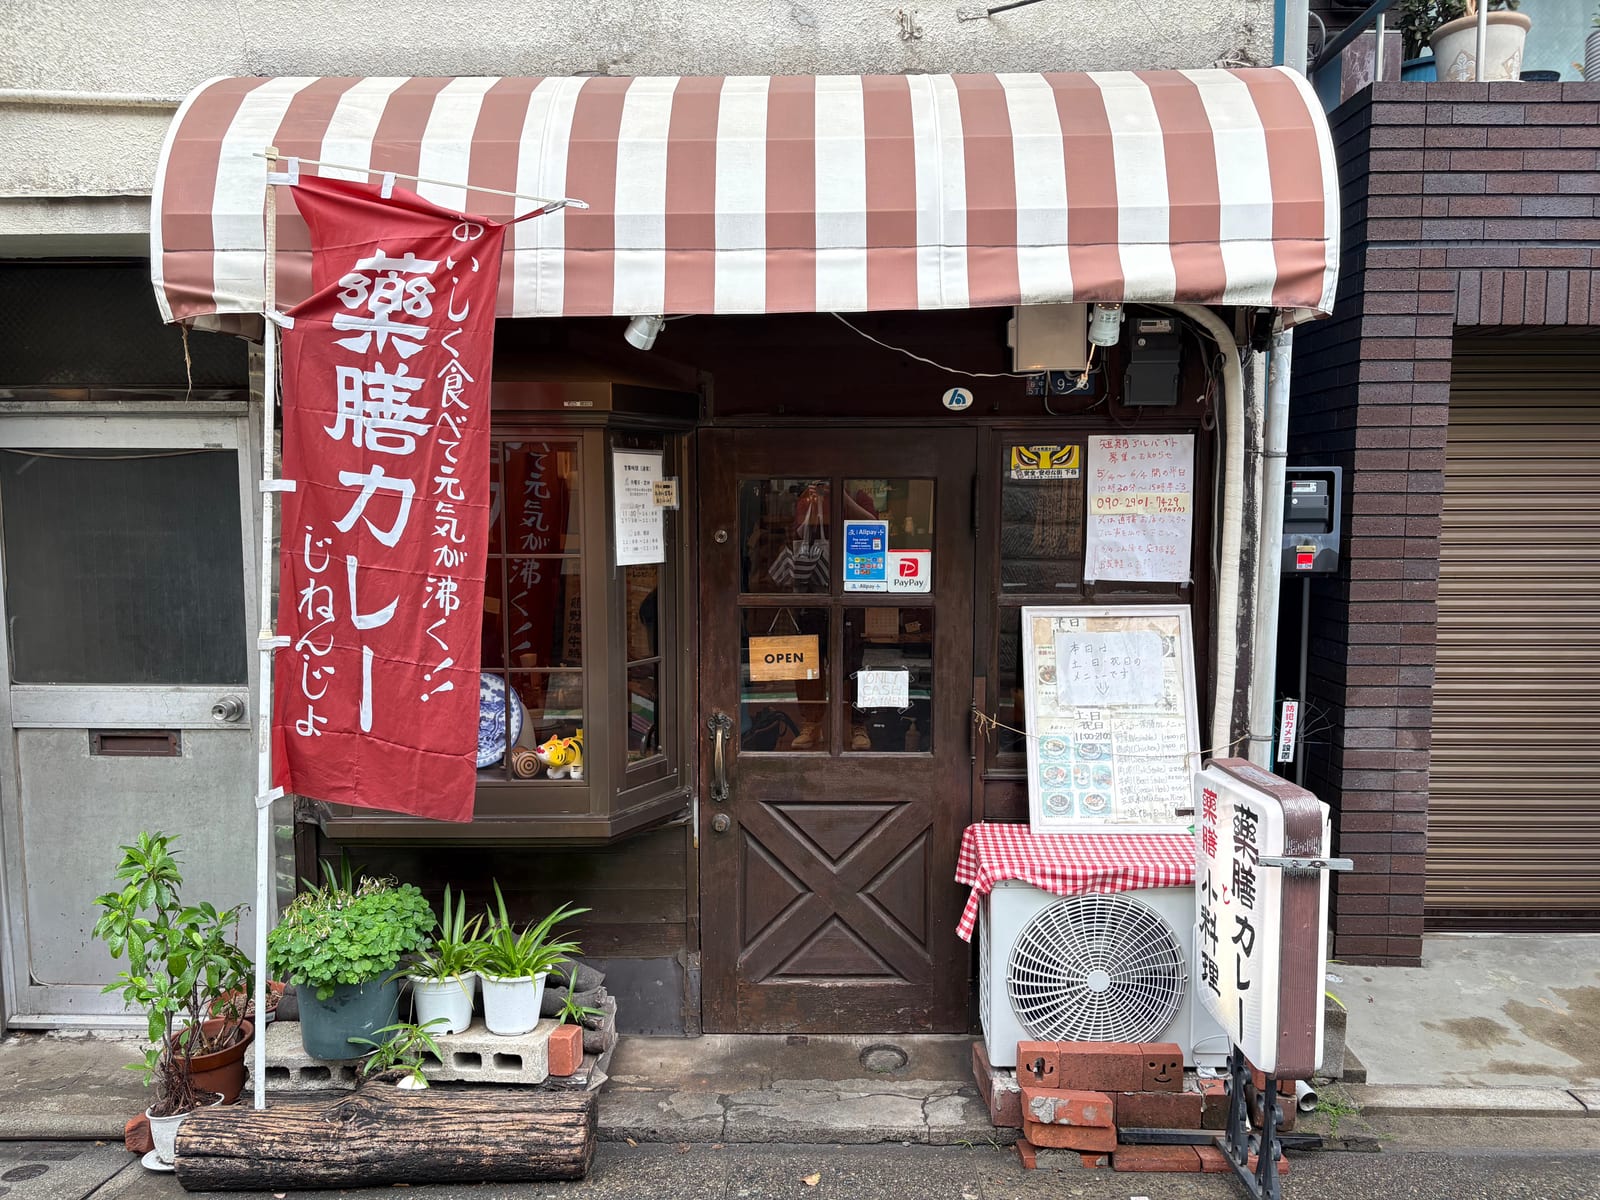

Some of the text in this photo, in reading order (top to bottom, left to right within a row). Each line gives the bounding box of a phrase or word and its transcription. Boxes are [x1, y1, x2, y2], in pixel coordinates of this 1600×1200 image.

[894, 579, 923, 588] PayPay
[764, 652, 804, 664] OPEN
[863, 685, 902, 696] CASH
[1221, 884, 1231, 905] と
[1199, 868, 1222, 999] 小料理
